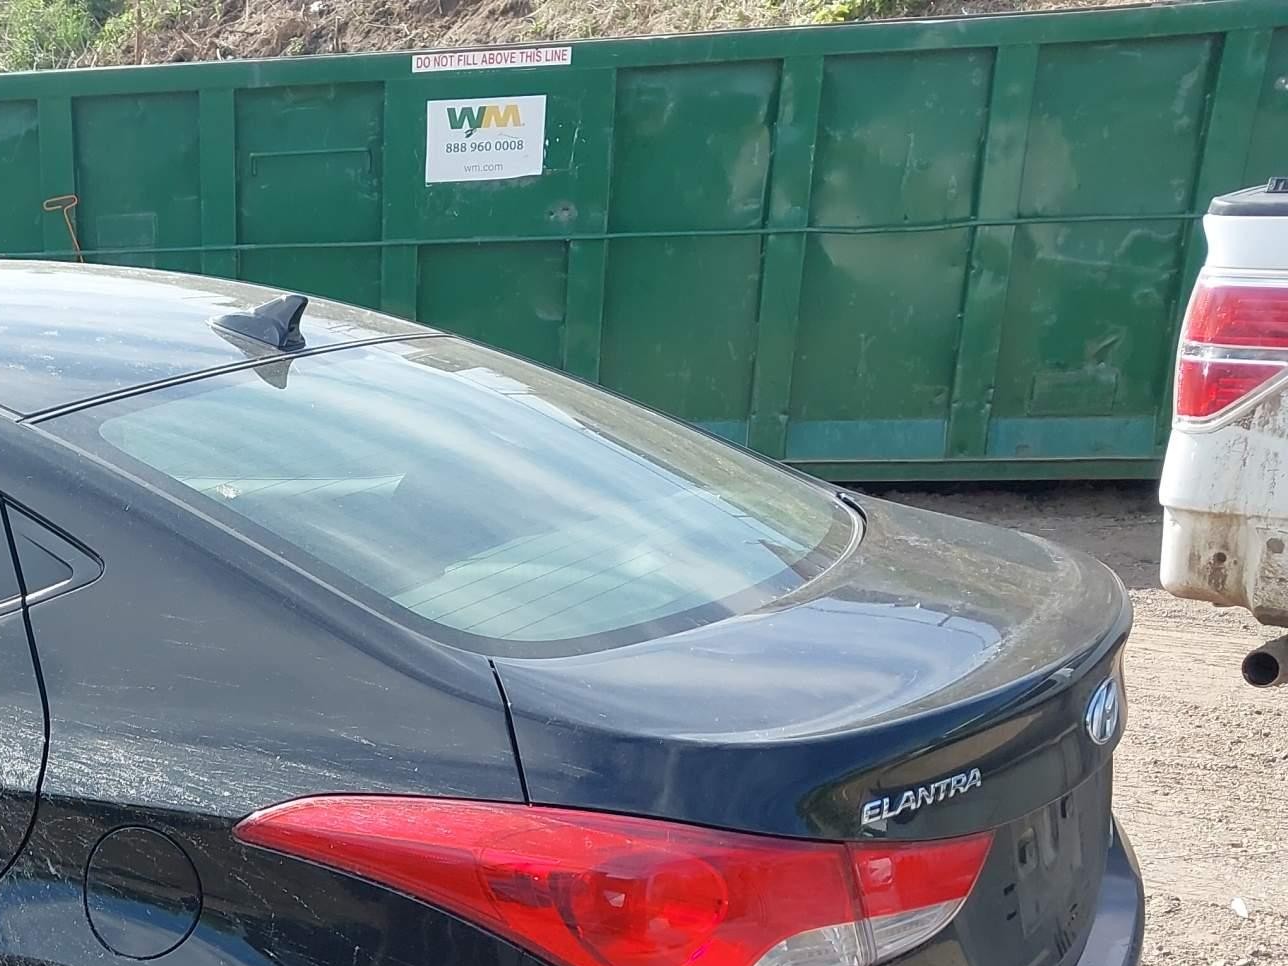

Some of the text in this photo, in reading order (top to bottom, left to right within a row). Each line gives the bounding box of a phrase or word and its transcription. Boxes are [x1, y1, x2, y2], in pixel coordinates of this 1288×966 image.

[416, 49, 568, 69] DO NOT FILL ABOVE THIS LINE
[446, 104, 522, 130] WM
[445, 140, 524, 154] 888 960 0008
[464, 162, 503, 173] wm.com
[861, 767, 982, 825] ELANTRA
